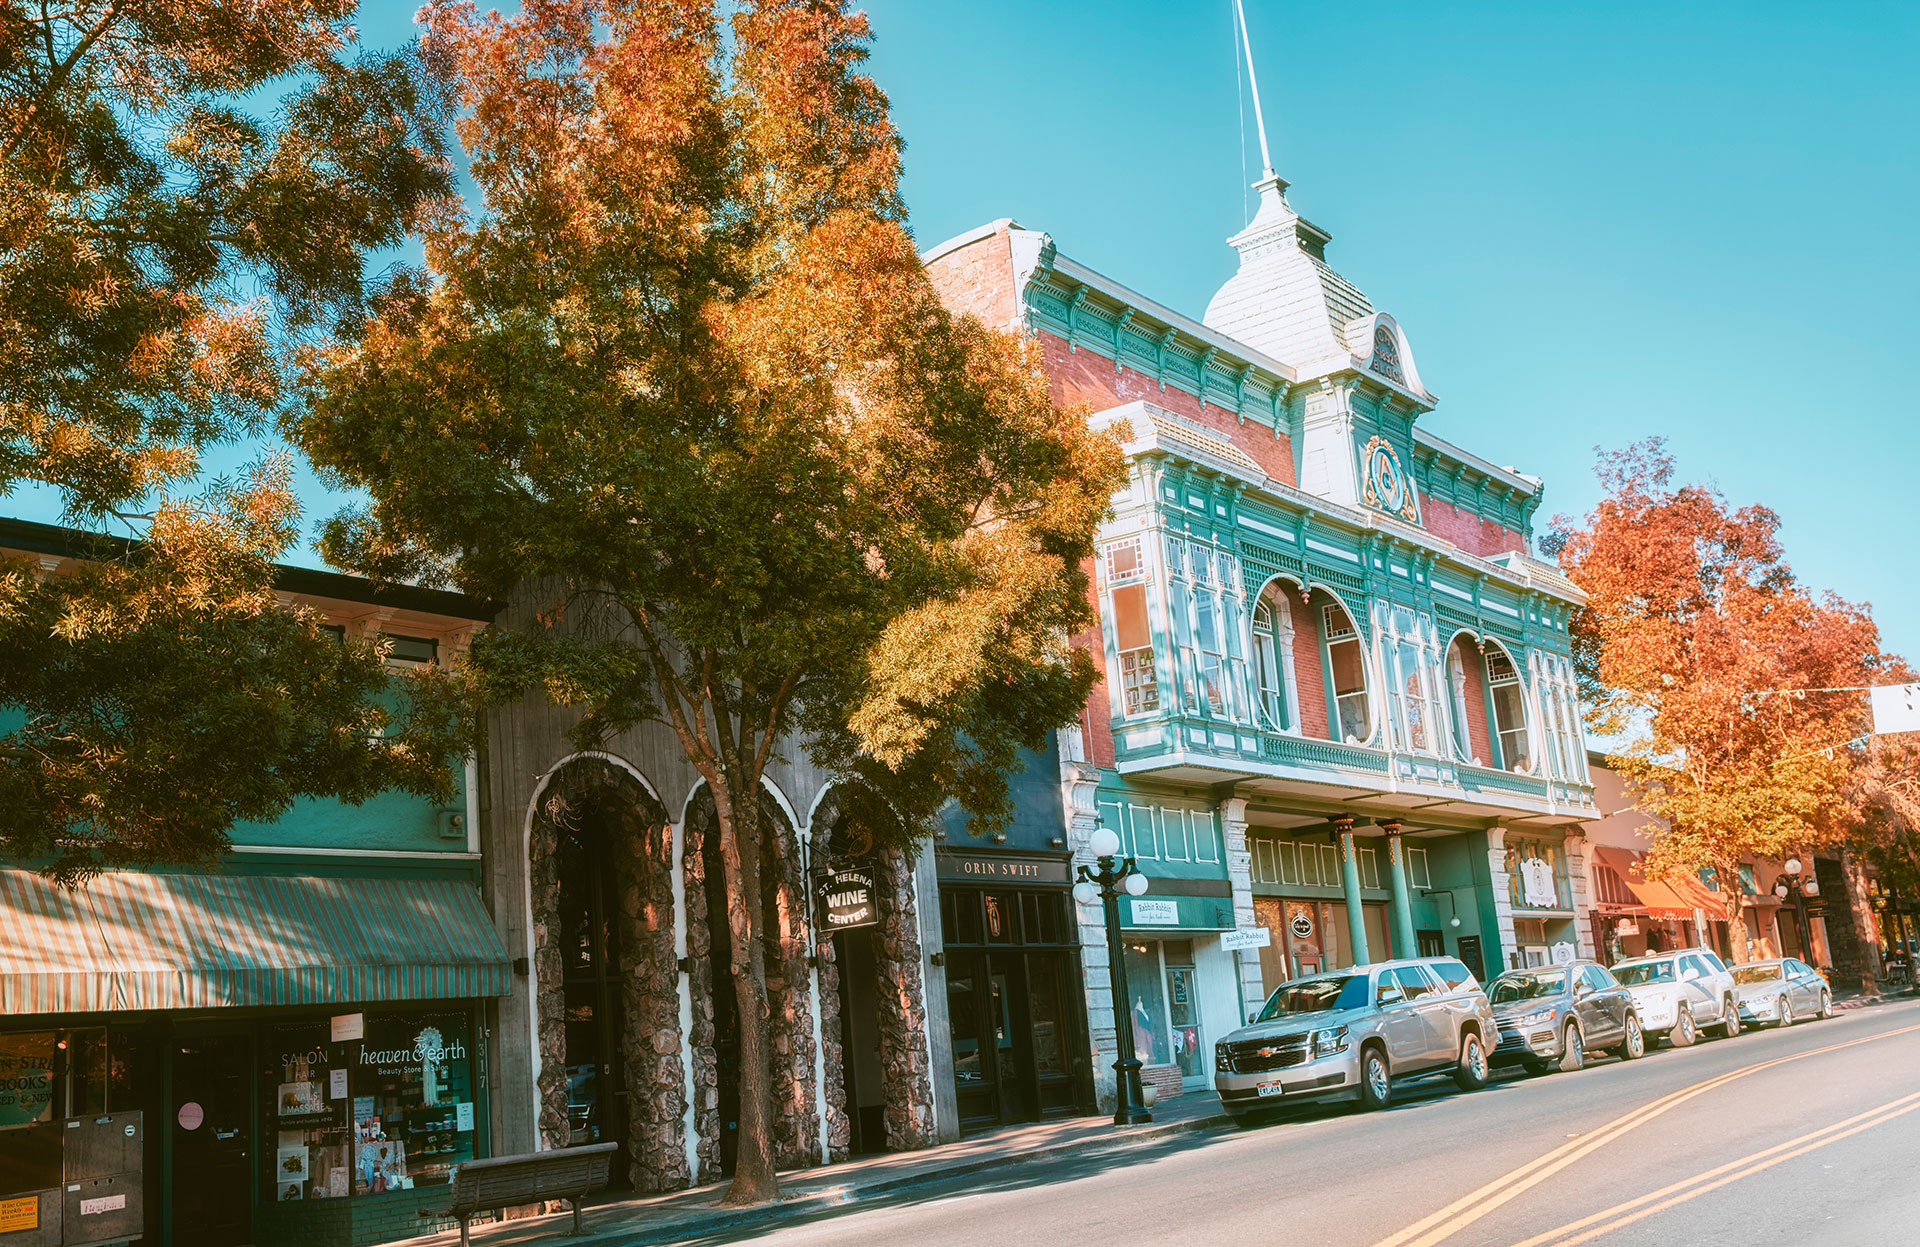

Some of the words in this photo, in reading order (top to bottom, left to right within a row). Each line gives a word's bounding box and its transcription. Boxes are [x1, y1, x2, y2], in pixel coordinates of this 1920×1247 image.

[964, 862, 995, 874] ORIN
[1002, 863, 1039, 877] SWIFT
[818, 883, 832, 897] ST.
[835, 873, 873, 888] HELENA
[826, 889, 868, 908] WINE
[827, 907, 869, 924] CENTER
[1225, 934, 1244, 943] Rabbit
[1246, 932, 1264, 940] Rabbit
[360, 1043, 410, 1065] heaven
[412, 1043, 427, 1062] &
[427, 1038, 466, 1060] earth
[281, 1050, 328, 1067] SALON
[295, 1070, 316, 1079] HAIR
[377, 1068, 401, 1076] Beauty
[403, 1066, 422, 1074] Store
[430, 1064, 449, 1072] Salon
[295, 1081, 315, 1090] SKIN
[294, 1092, 319, 1101] NAILS
[286, 1102, 325, 1113] MASSAGE
